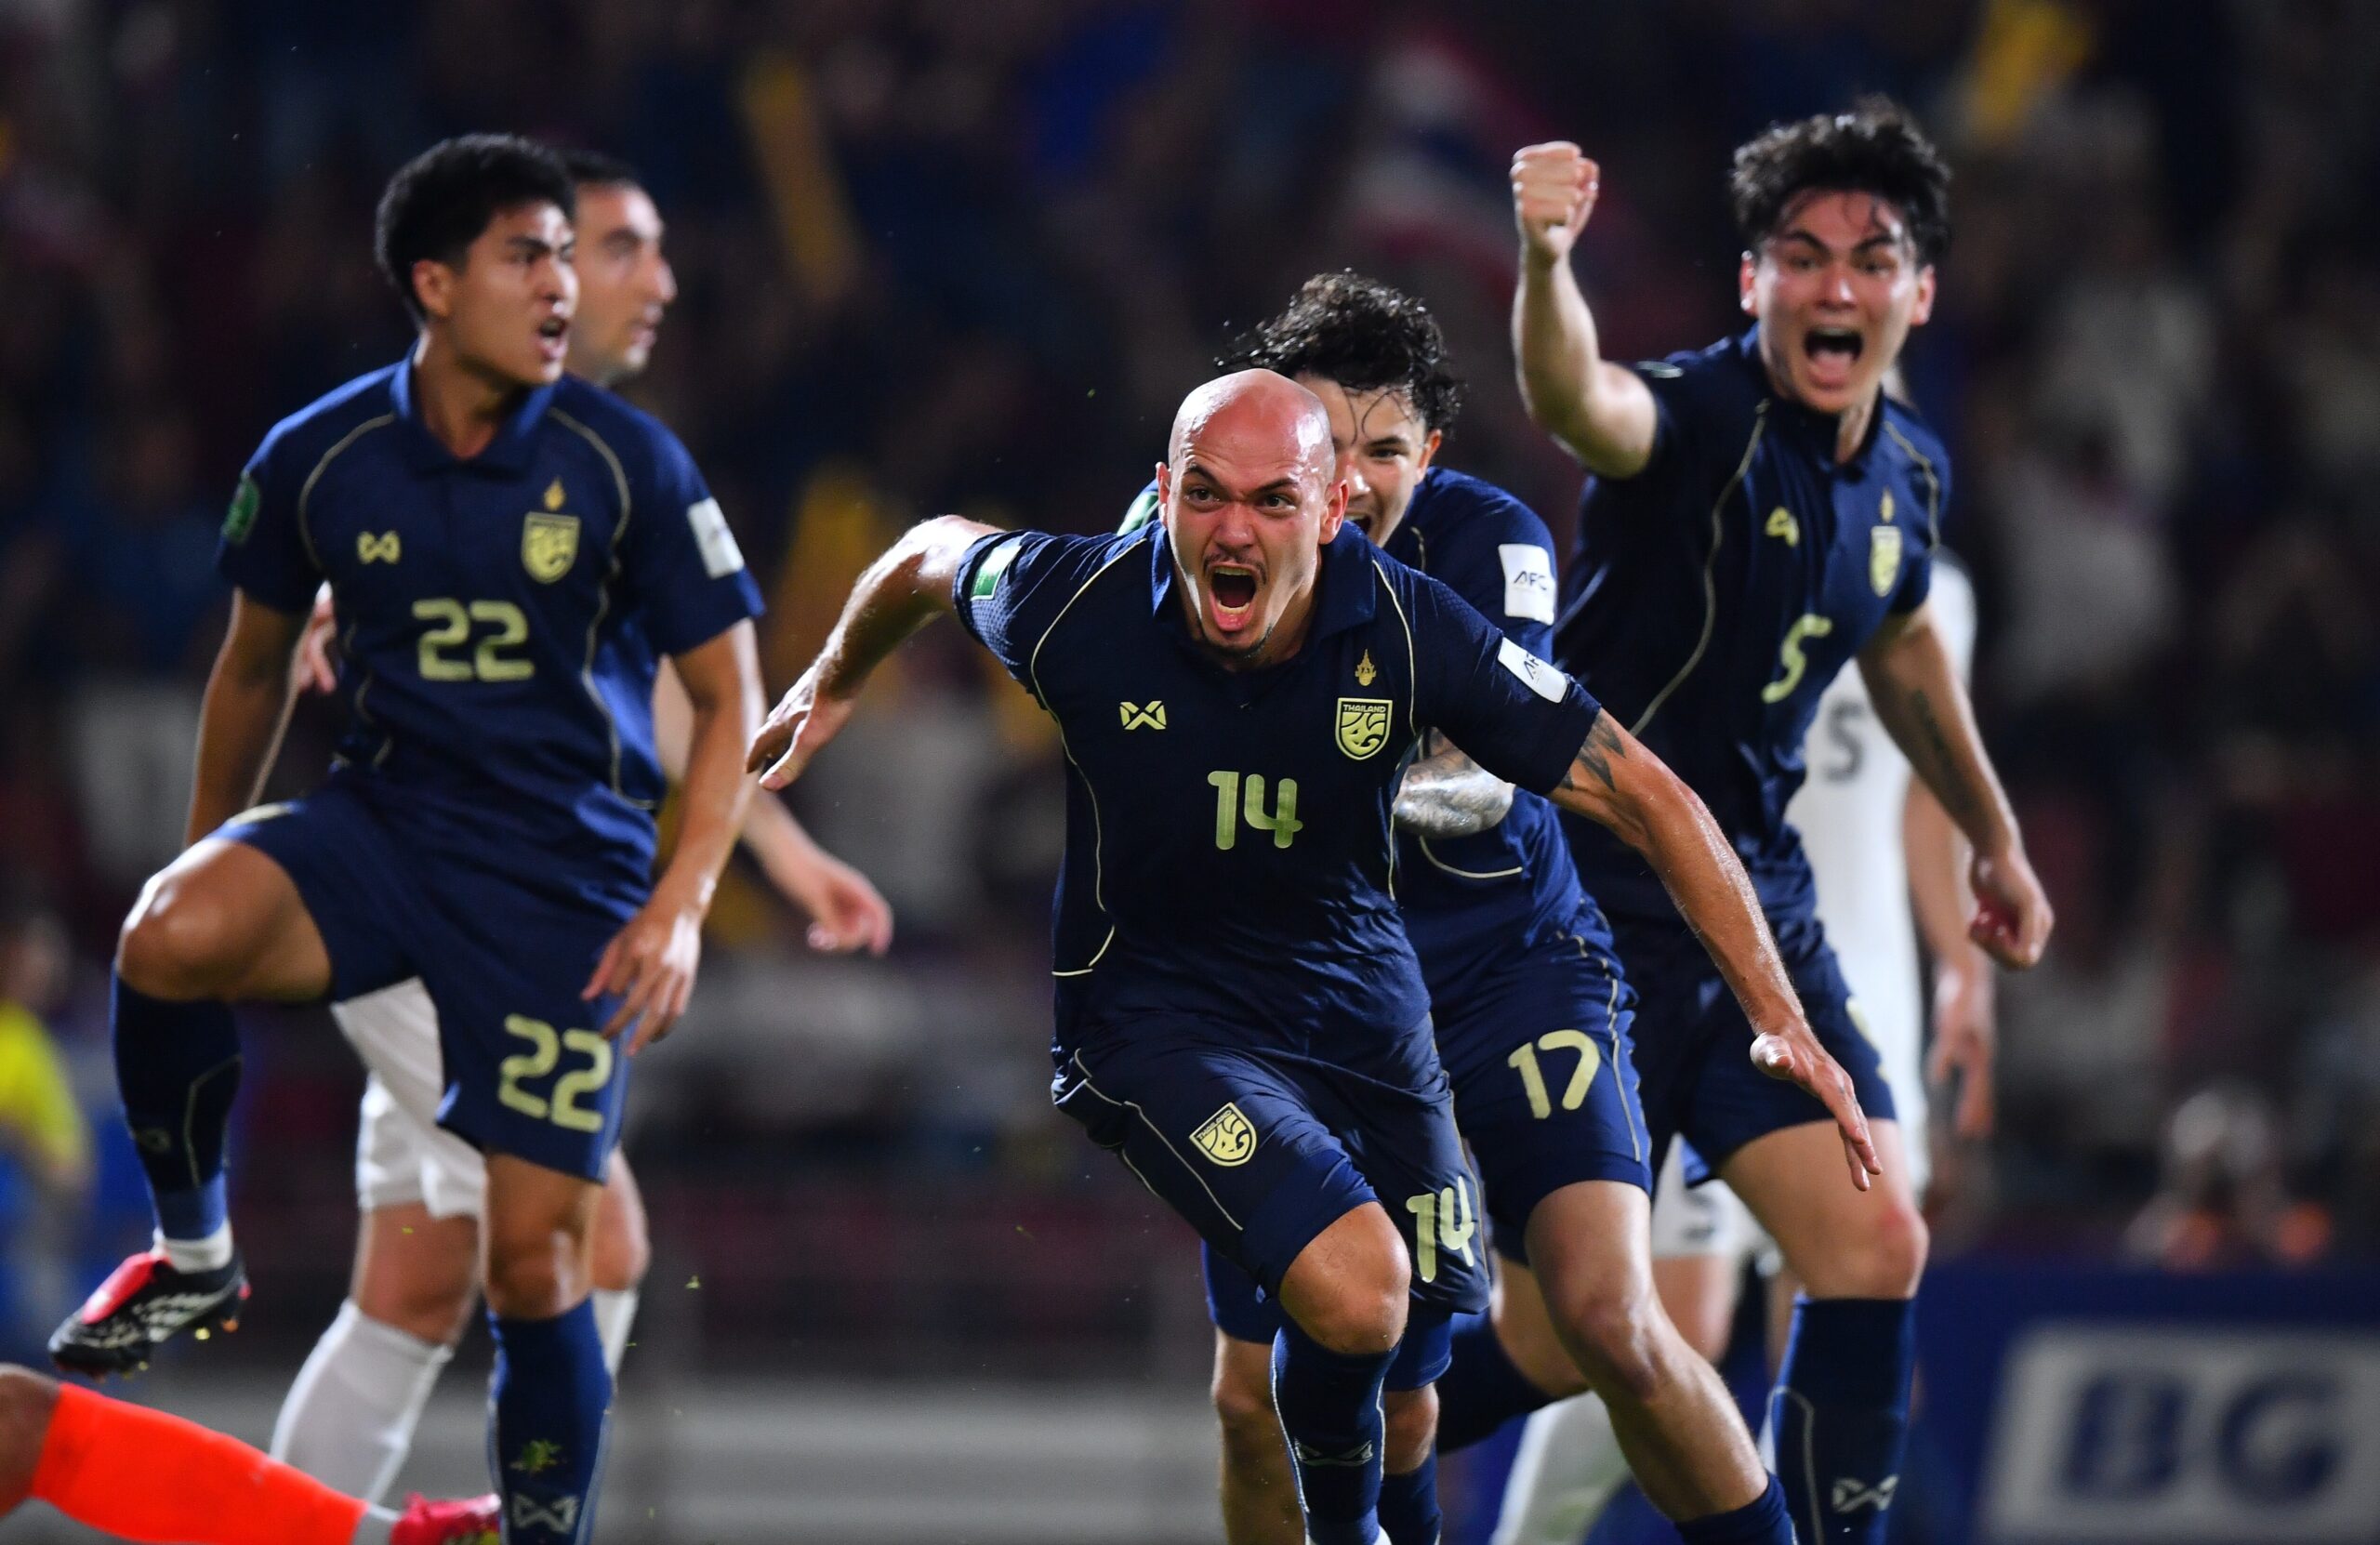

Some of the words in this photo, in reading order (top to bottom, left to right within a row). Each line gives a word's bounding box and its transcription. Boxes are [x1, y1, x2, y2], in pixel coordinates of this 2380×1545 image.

[1513, 570, 1548, 591] AFC
[412, 597, 536, 682] 22
[1762, 613, 1832, 704] 5
[1342, 704, 1386, 713] THAILAND
[1207, 770, 1303, 851] 14
[498, 1012, 614, 1132] 22
[1507, 1029, 1601, 1119] 17
[1405, 1175, 1474, 1283] 14
[2057, 1370, 2343, 1508] BG
